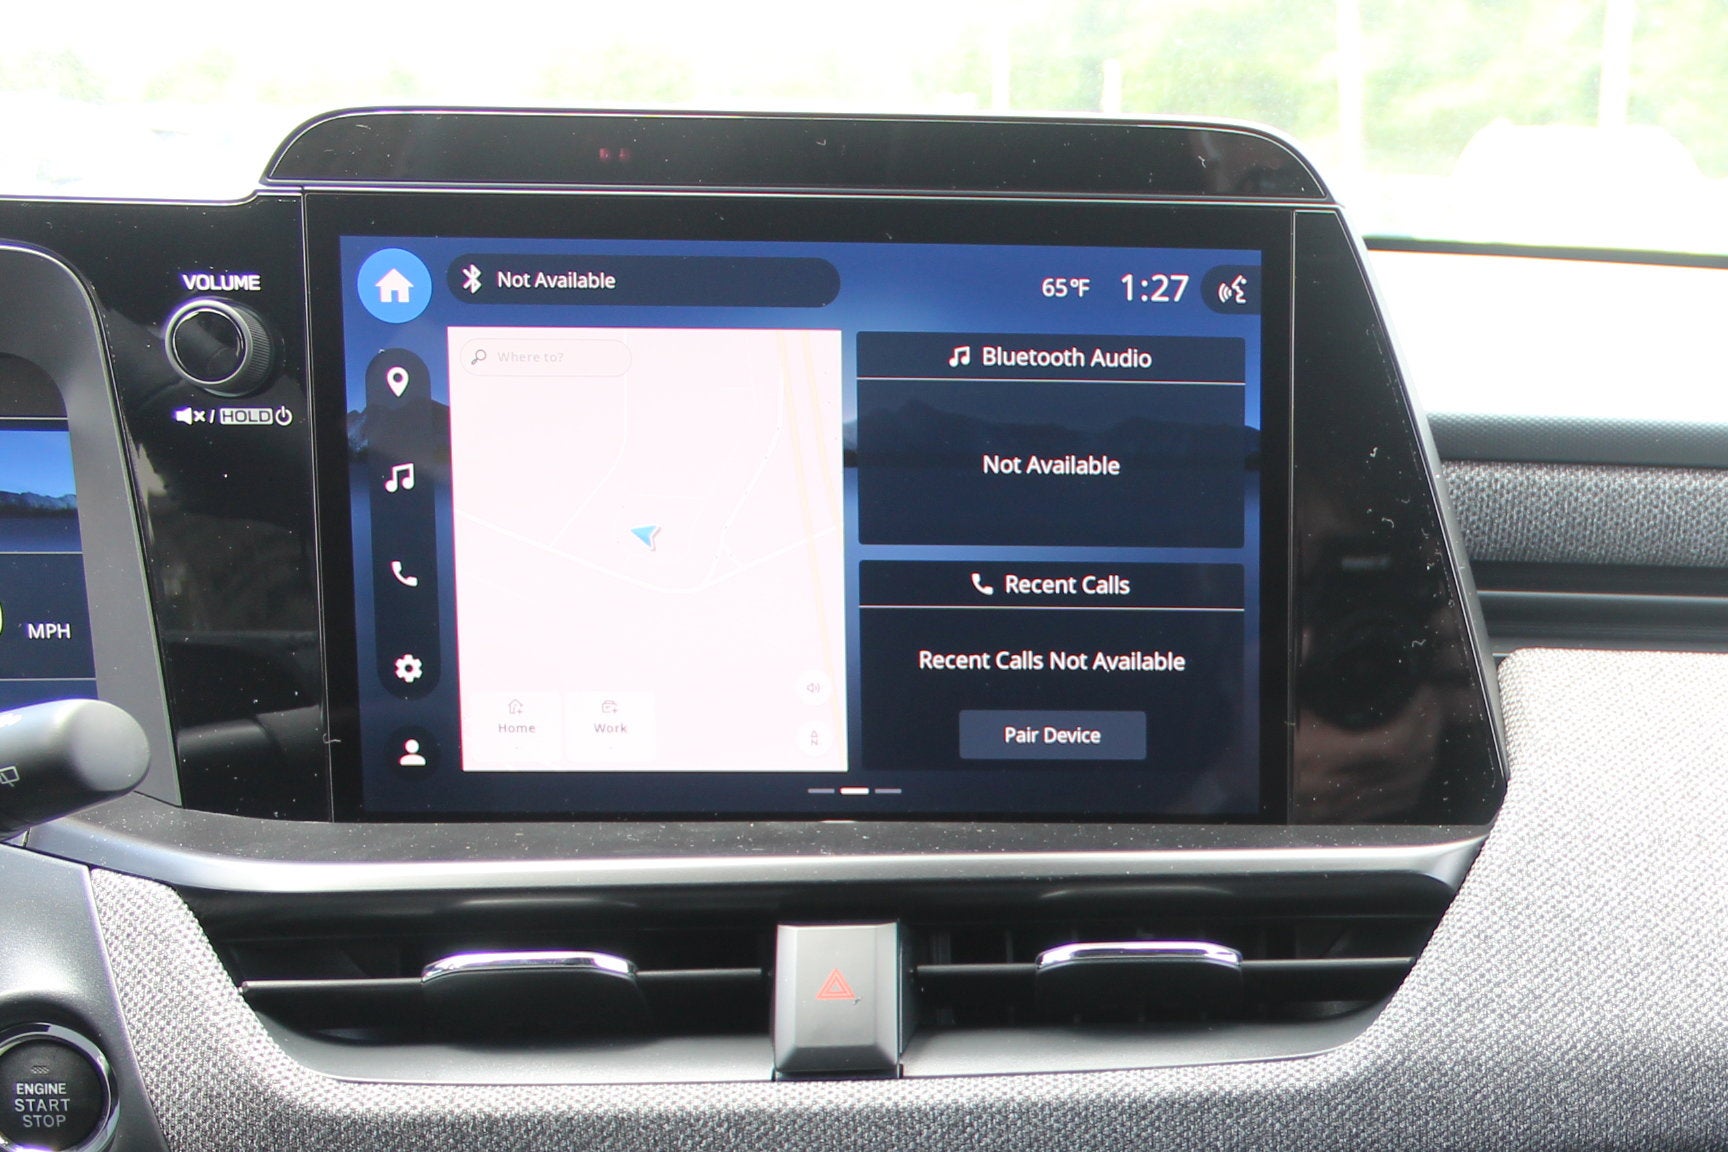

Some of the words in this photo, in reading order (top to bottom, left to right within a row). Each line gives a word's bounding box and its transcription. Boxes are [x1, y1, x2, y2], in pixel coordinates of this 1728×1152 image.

[181, 274, 261, 291] VOLUME
[497, 271, 531, 289] Not
[534, 272, 616, 289] Available
[1042, 278, 1090, 297] 65°F
[1121, 274, 1190, 303] 1:27
[497, 351, 540, 363] Where
[544, 351, 565, 363] to?
[982, 347, 1086, 368] Bluetooth
[1090, 348, 1152, 369] Audio
[221, 408, 271, 424] HOLD
[983, 455, 1021, 475] Not
[1026, 455, 1121, 476] Available
[1005, 575, 1077, 595] Recent
[1081, 575, 1130, 596] Calls
[28, 622, 71, 641] MPH
[919, 650, 991, 671] Recent
[995, 650, 1044, 671] Calls
[1049, 652, 1088, 672] Not
[1093, 652, 1186, 672] Available
[498, 722, 536, 734] Home
[594, 722, 628, 734] Work
[1004, 727, 1039, 744] Pair
[1044, 727, 1101, 745] Device
[16, 1082, 67, 1095] ENGINE
[14, 1098, 70, 1112] START
[23, 1114, 66, 1128] STOP
